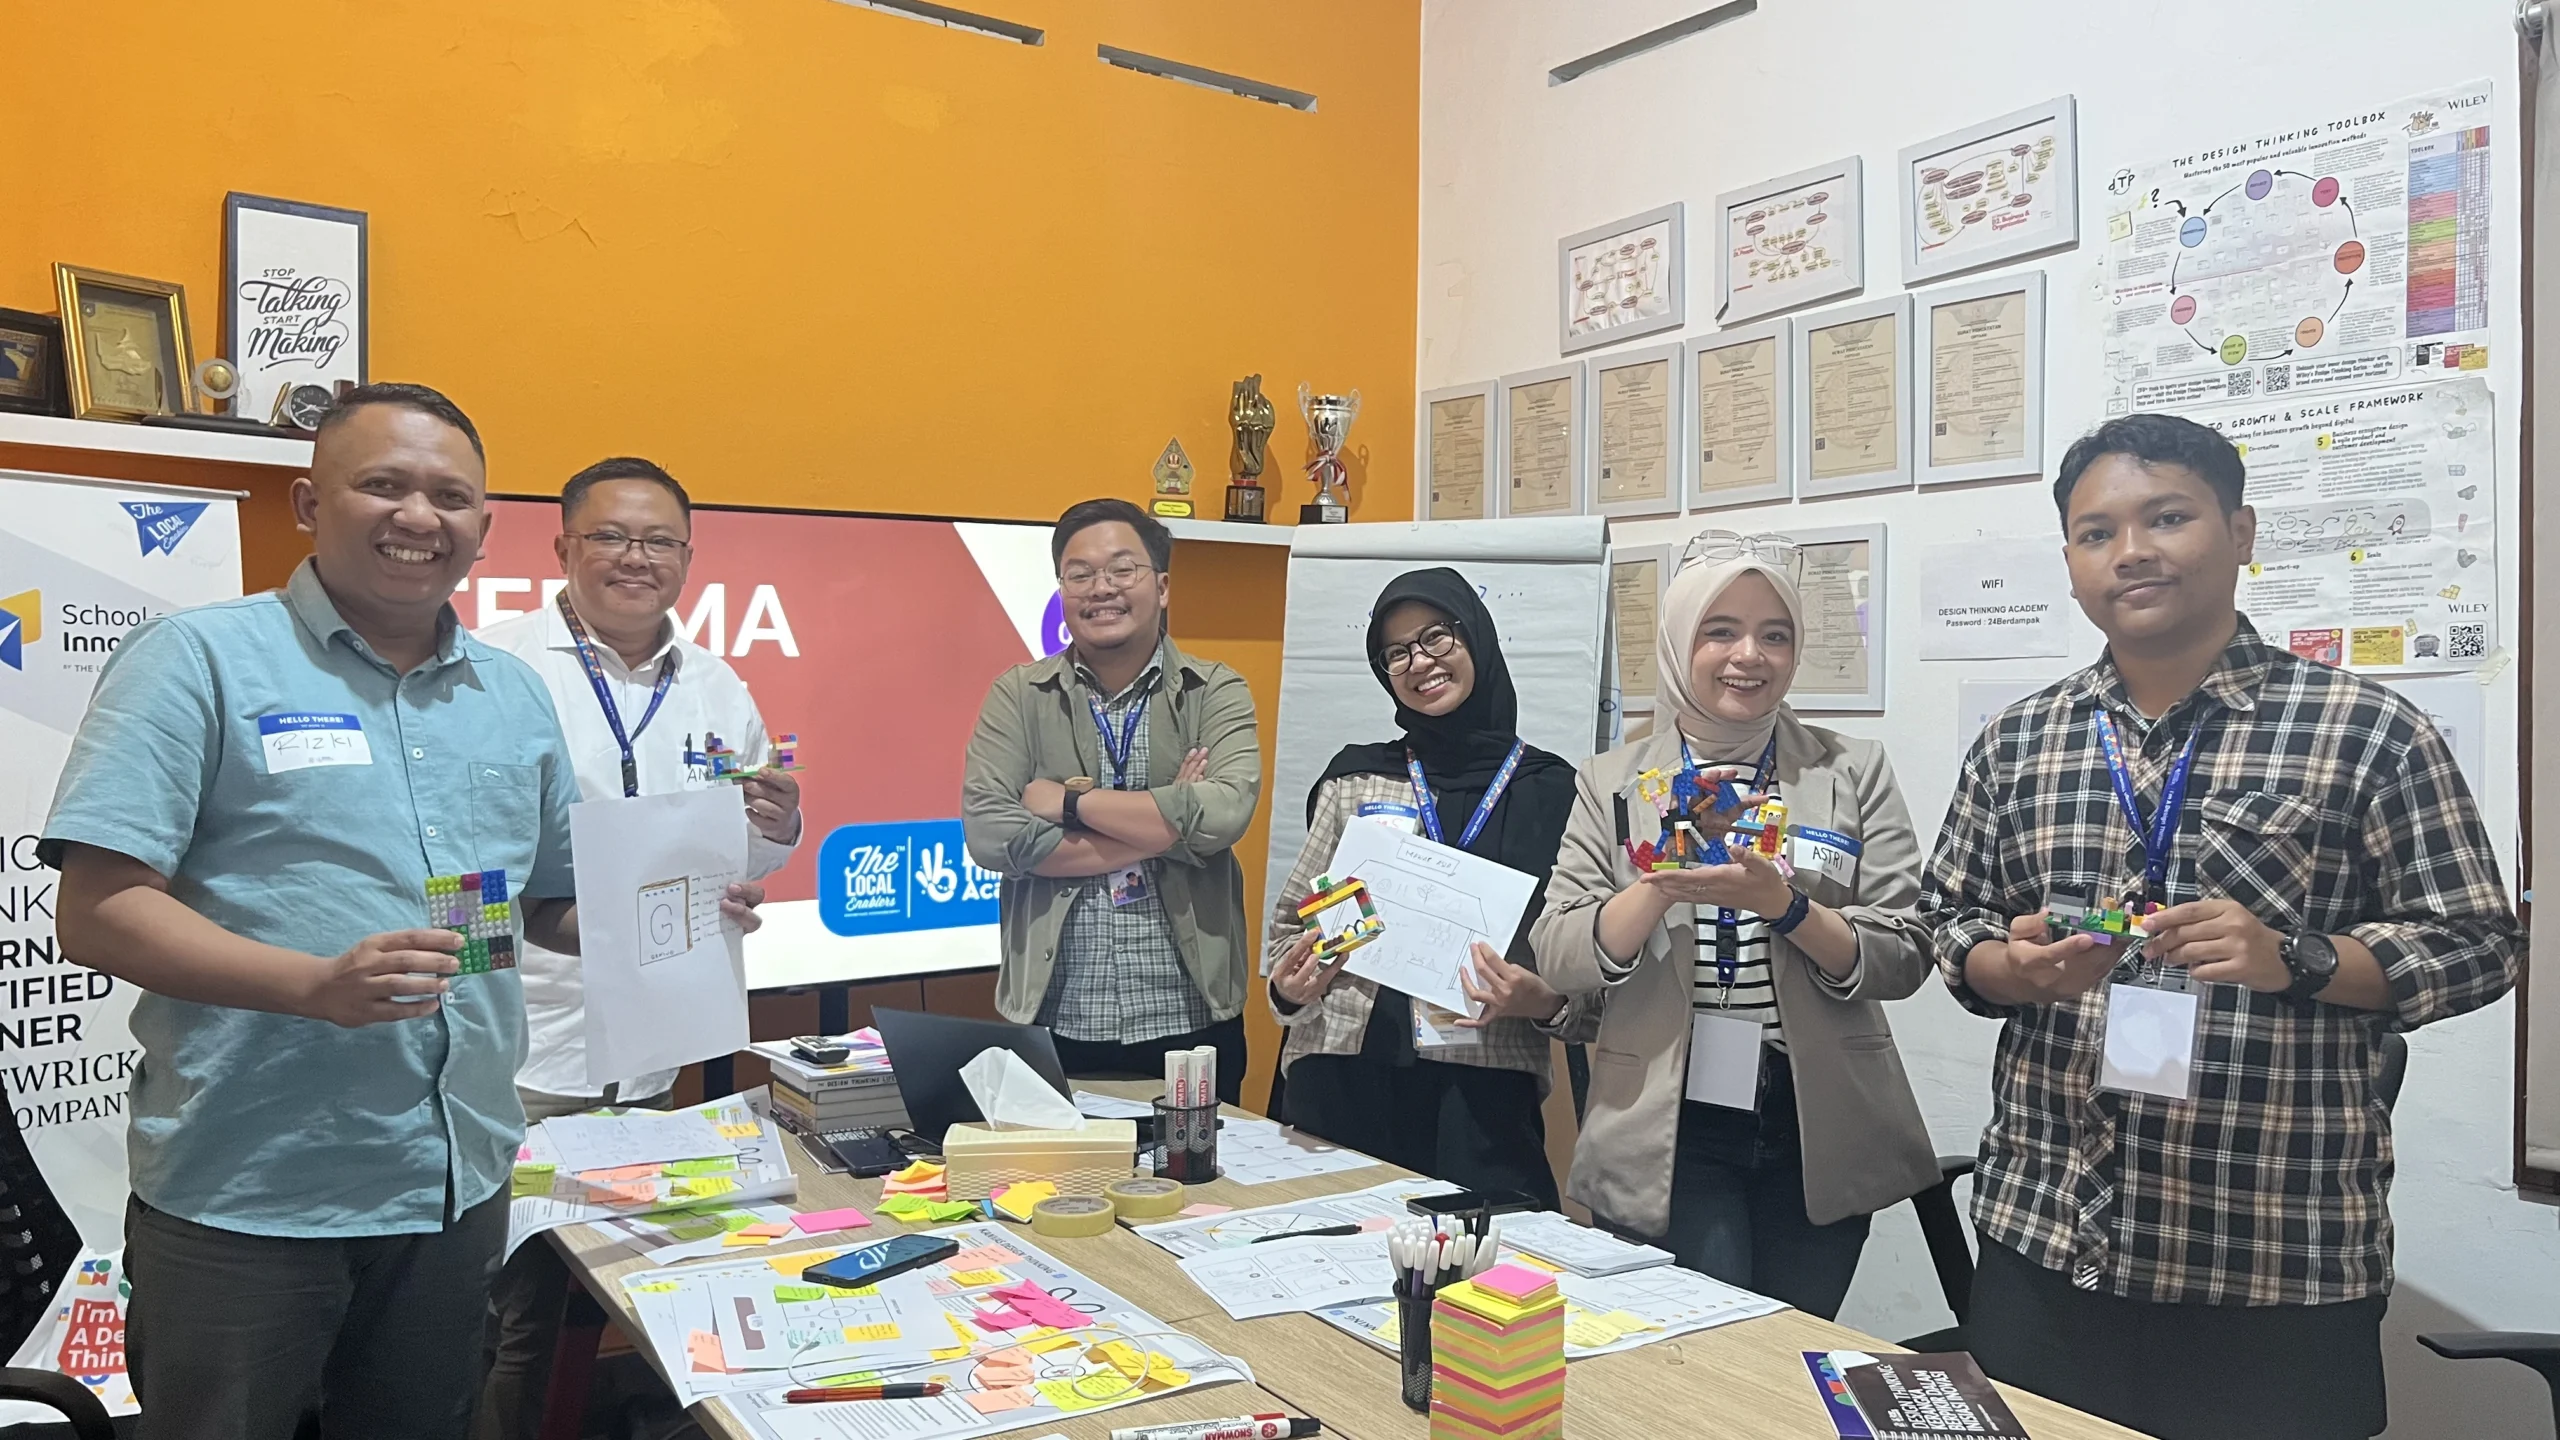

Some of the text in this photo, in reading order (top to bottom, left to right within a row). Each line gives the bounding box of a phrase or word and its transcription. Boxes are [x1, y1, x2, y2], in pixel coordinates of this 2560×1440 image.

[2447, 94, 2488, 110] WILEY
[2172, 111, 2386, 168] THE DESIGN THINKING TOOLBOX
[263, 268, 295, 277] STOP
[239, 276, 351, 328] Talking
[263, 315, 301, 325] START
[248, 317, 349, 369] Making
[2231, 414, 2276, 429] GROWTH
[2283, 412, 2292, 421] &
[2300, 405, 2340, 418] SCALE
[2349, 392, 2424, 412] FRAMEWORK
[2317, 436, 2324, 446] 5
[130, 503, 164, 519] The
[147, 514, 184, 541] LOCAL
[2350, 552, 2357, 561] 6
[1981, 578, 2004, 589] WIFI
[62, 604, 146, 627] School
[1938, 604, 2049, 616] DESIGN THINKING ACADEMY
[2447, 603, 2489, 614] WILEY
[1945, 618, 1982, 627] Password
[1987, 616, 2040, 627] 24Berdampak
[279, 716, 344, 725] HELLO THERE!
[1805, 829, 1850, 846] HELLO THERE!
[845, 845, 899, 877] The
[1812, 845, 1844, 871] ASTRI
[846, 872, 896, 897] LOCAL
[846, 896, 896, 912] Enablers
[650, 903, 673, 946] G
[827, 1080, 849, 1088] DESIGN
[76, 1302, 114, 1324] I'm
[70, 1327, 89, 1346] A
[1928, 1370, 1964, 1401] INOVASI
[1908, 1388, 1949, 1430] KERANGKA
[1911, 1369, 1967, 1431] BERPIKIR DALAM
[1900, 1401, 1929, 1429] DESIGN
